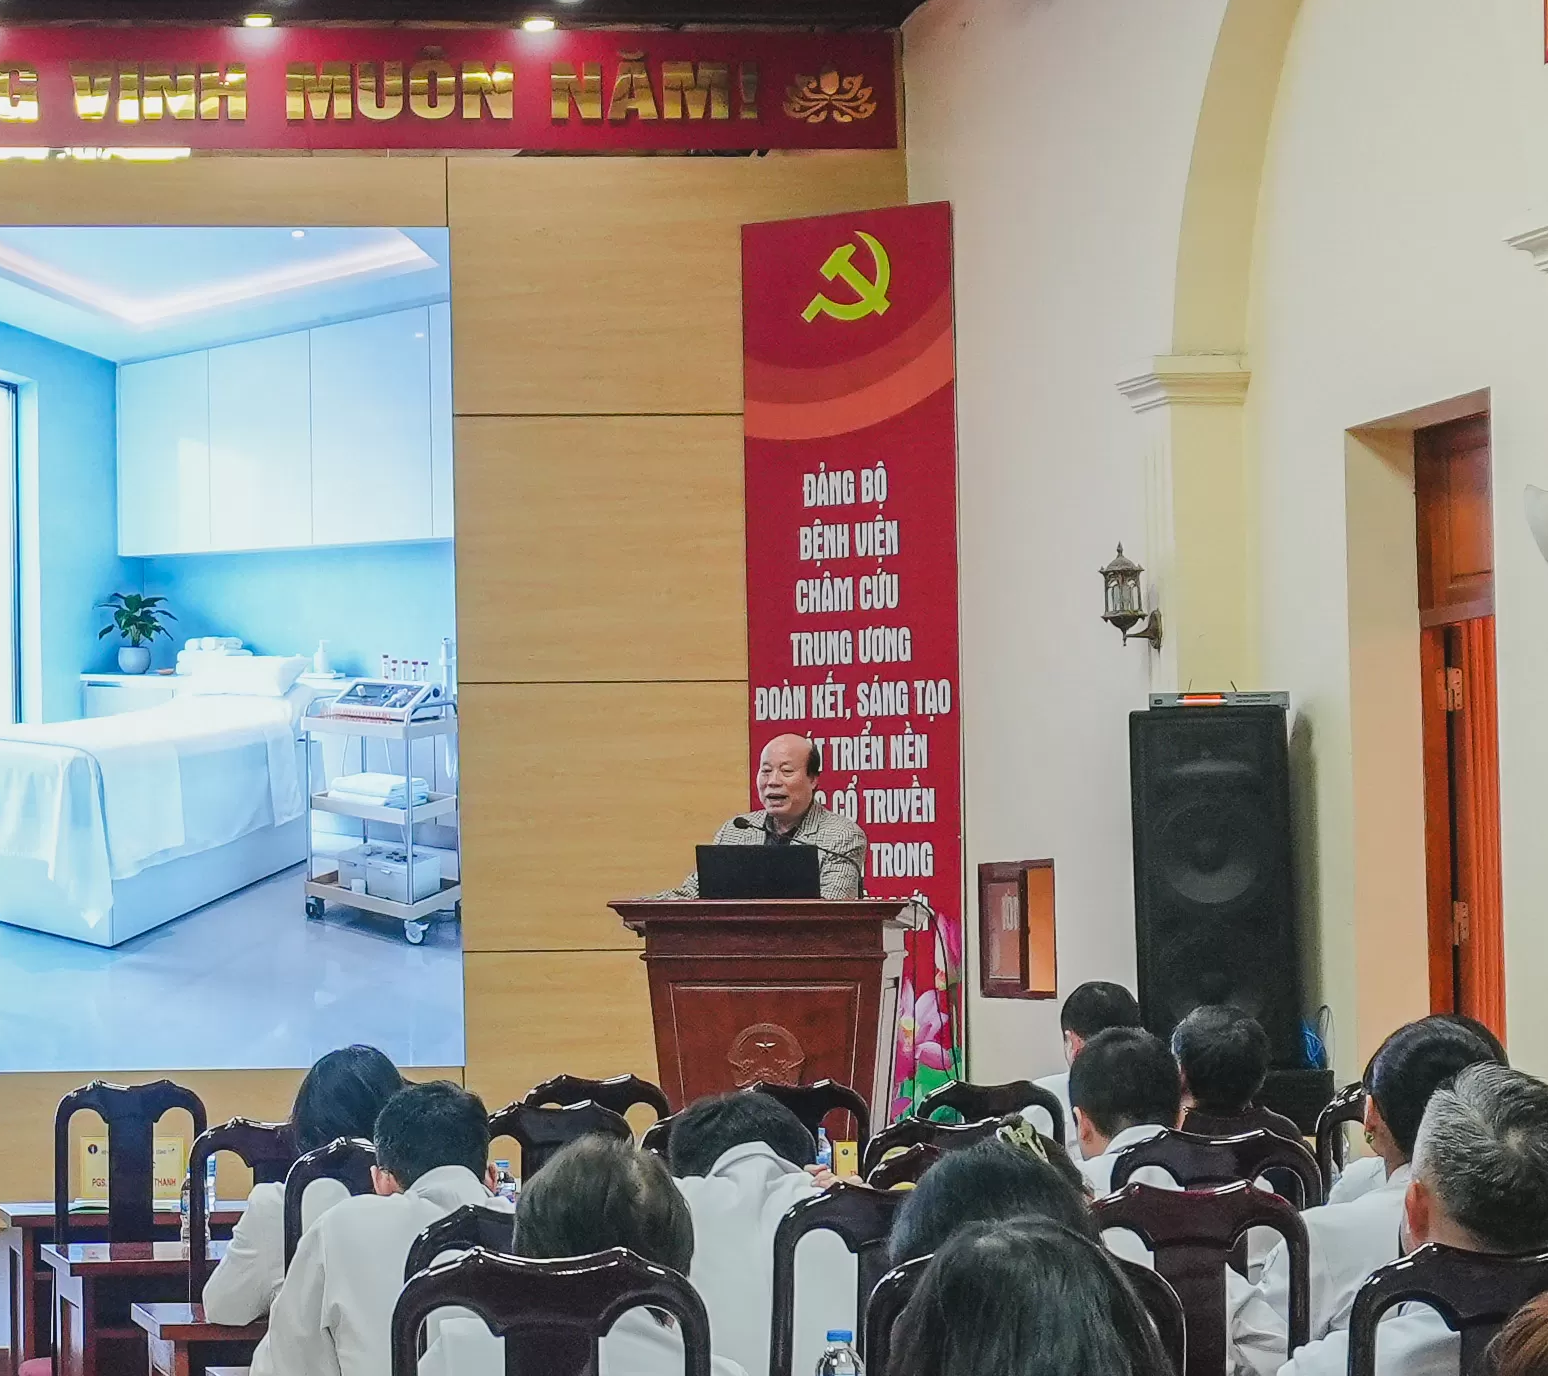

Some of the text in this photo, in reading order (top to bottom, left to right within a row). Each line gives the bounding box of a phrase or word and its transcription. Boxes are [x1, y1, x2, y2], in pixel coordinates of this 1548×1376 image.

[69, 61, 249, 123] VINH
[285, 45, 515, 123] MUÔN
[550, 48, 760, 122] NĂM!
[803, 461, 887, 509] ĐẢNG BỘ
[800, 515, 898, 566] BỆNH VIỆN
[796, 568, 898, 613] CHÂM CỨU
[790, 626, 911, 666] TRUNG ƯƠNG
[755, 671, 950, 721] ĐOÀN KẾT, SÁNG TẠO
[830, 721, 883, 770] TRIỂN
[891, 722, 927, 769] NỀN
[863, 775, 935, 823] TRUYỀN
[870, 842, 933, 877] TRONG
